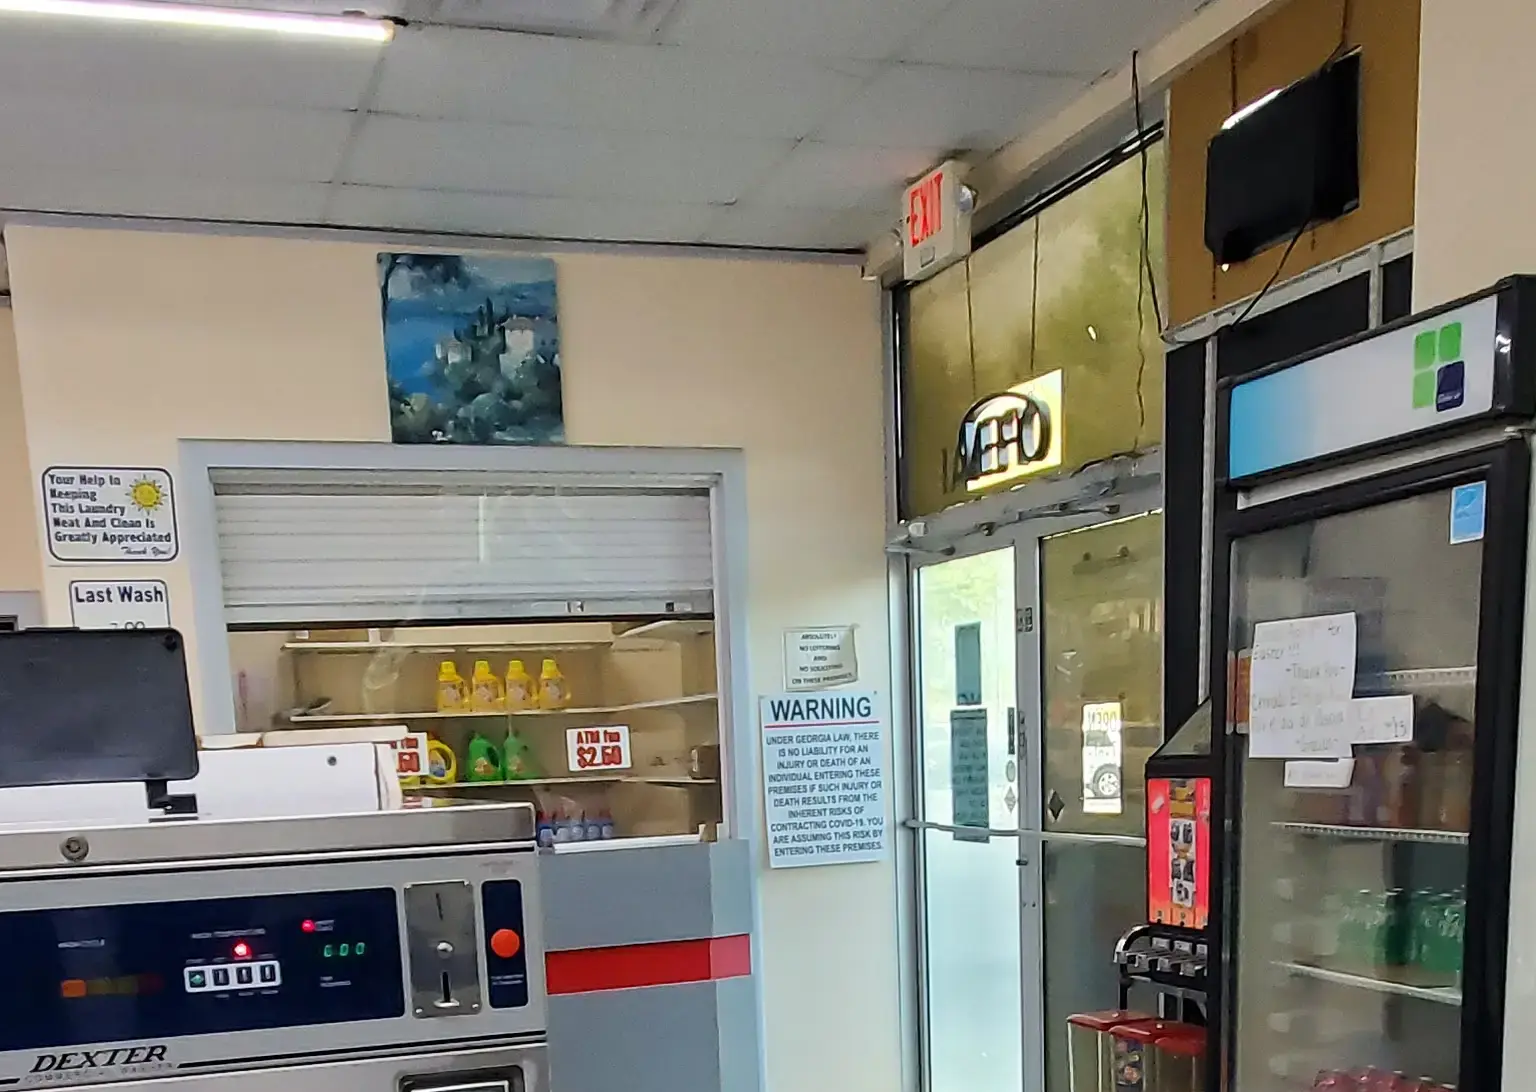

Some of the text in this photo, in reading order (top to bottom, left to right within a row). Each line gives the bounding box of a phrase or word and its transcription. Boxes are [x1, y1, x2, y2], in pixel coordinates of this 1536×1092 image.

[909, 172, 944, 248] EXIT
[48, 473, 75, 485] Your
[79, 474, 105, 488] Help
[49, 488, 98, 502] Keeping
[51, 502, 126, 517] This Laundry
[53, 517, 156, 529] Neat And Clean Is
[54, 531, 172, 546] Greatly Appreciated
[74, 586, 164, 603] Last Wash
[770, 696, 872, 722] WARNING
[766, 735, 794, 745] UNDER
[796, 734, 832, 744] GEORGIA
[854, 731, 880, 741] THERE
[778, 744, 869, 757] IS NO LIABILITY FOR AN
[777, 756, 871, 769] INJURY OR DEATH OF AN
[768, 768, 881, 782] INDIVIDUAL ENTERING THESE
[768, 780, 882, 795] PREMISES IF SUCH INJURY OR
[773, 792, 878, 807] DEATH RESULTS FROM THE
[788, 806, 865, 818] INHERENT RISKS OF
[770, 821, 827, 832] CONTRACTING
[868, 817, 884, 826] YOU
[773, 829, 883, 844] ARE ASSUMING THIS RISK BY
[774, 846, 814, 857] ENTERING
[816, 843, 841, 853] THESE
[29, 1044, 168, 1073] DEXTER
